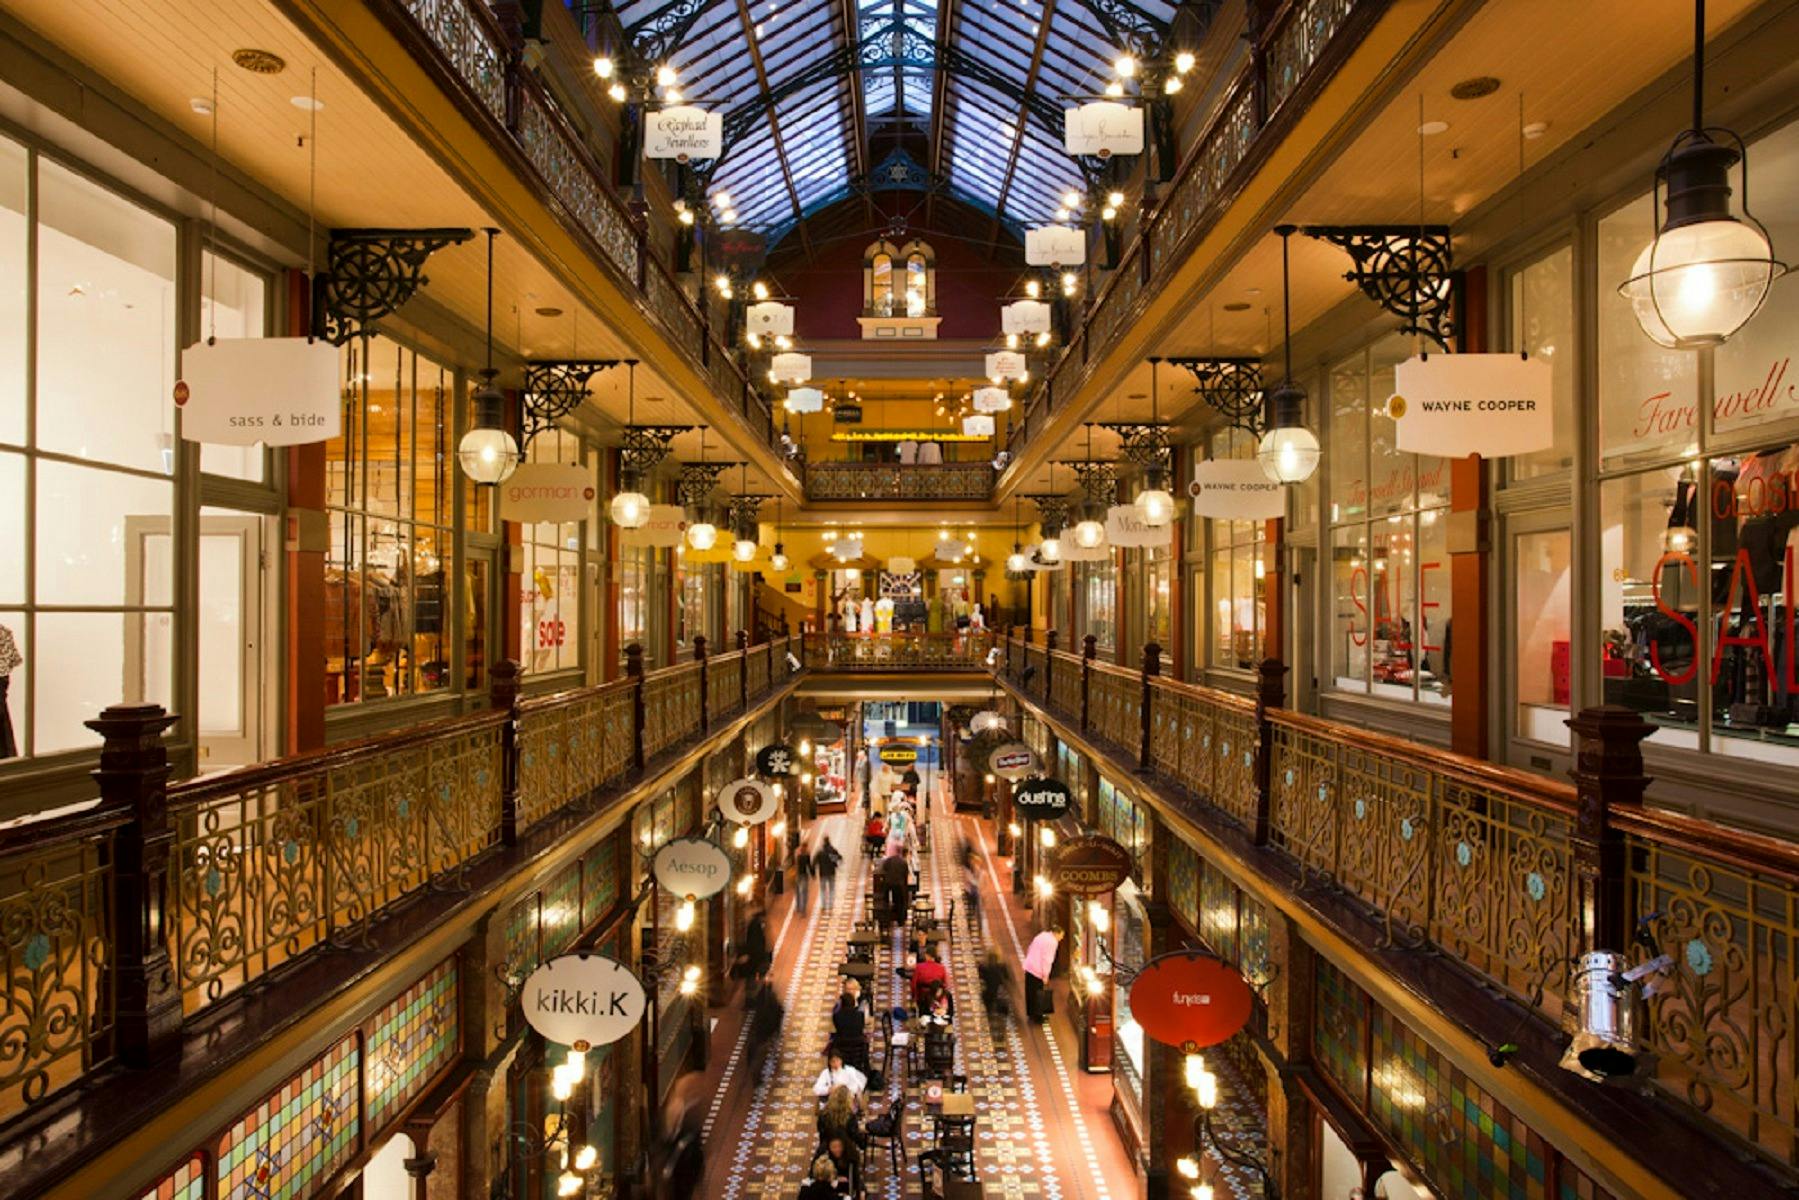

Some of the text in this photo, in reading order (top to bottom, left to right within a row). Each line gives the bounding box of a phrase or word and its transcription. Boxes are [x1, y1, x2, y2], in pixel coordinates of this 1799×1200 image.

[1633, 357, 1790, 438] Farewell
[1422, 400, 1536, 412] WAYNE COOPER
[229, 413, 325, 427] sass & bide
[508, 487, 577, 502] gorman
[1204, 483, 1278, 491] WAYNE COOPER
[1350, 562, 1441, 651] SALE
[666, 858, 718, 878] Aesop
[1060, 870, 1118, 881] COOMBS
[536, 988, 629, 1017] kikki.K
